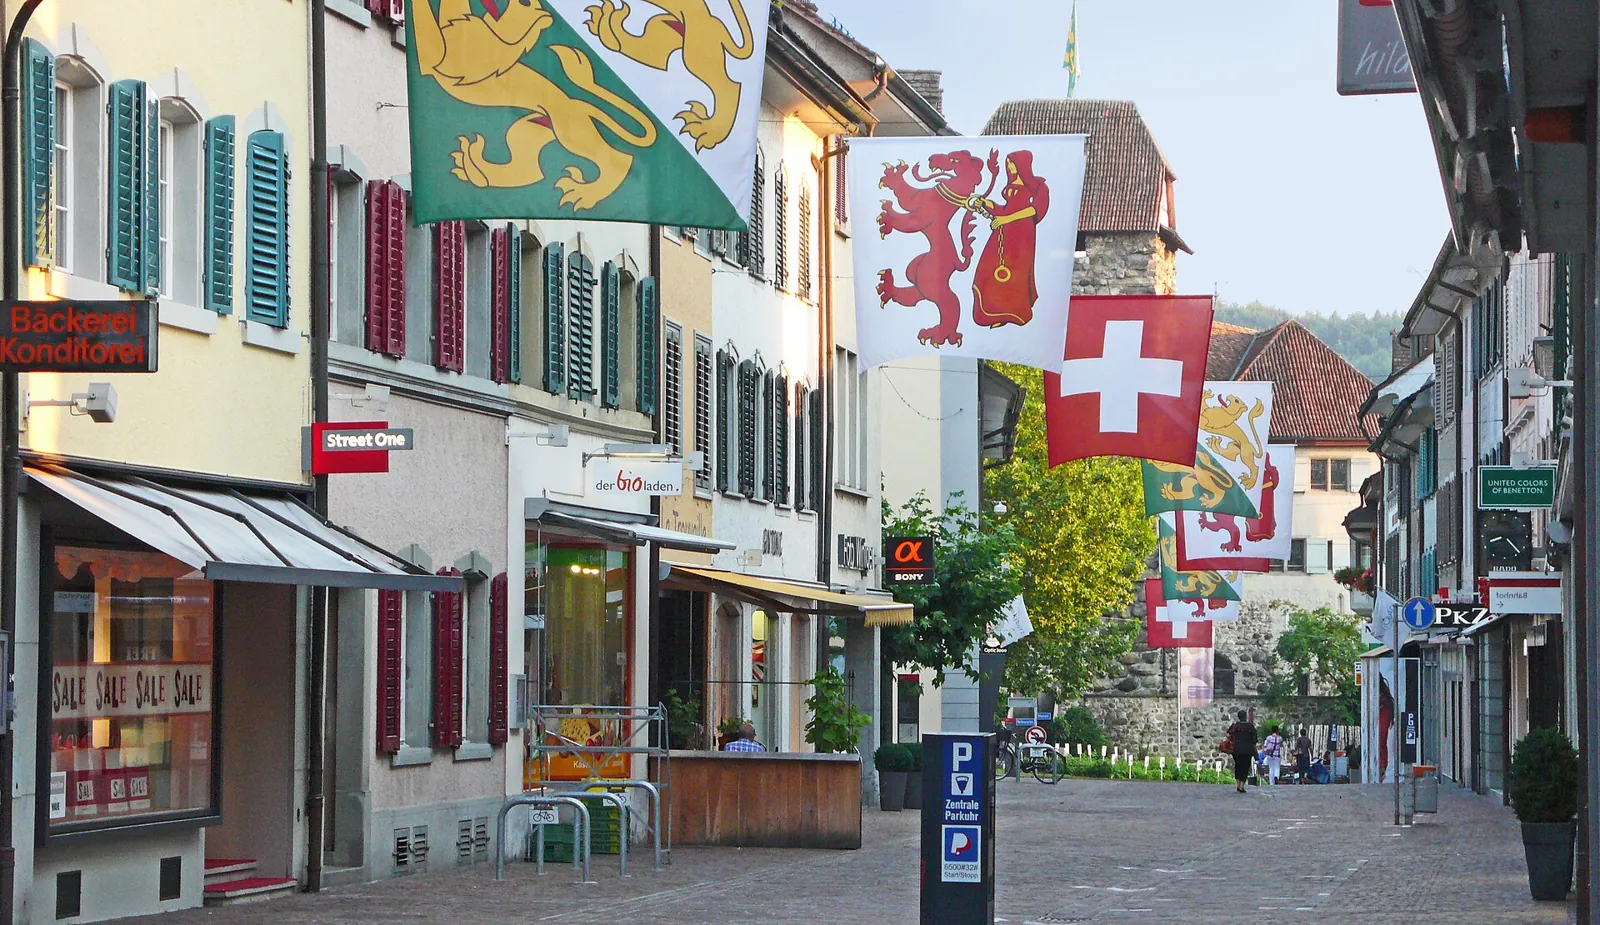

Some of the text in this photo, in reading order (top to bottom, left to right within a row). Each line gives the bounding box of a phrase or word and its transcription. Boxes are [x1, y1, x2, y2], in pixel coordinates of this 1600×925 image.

[11, 305, 137, 333] Bäckerei
[0, 336, 145, 364] Konditorei
[327, 432, 405, 447] Street One
[894, 573, 924, 581] SONY
[53, 669, 203, 713] SALE SALE SALE SALE
[952, 742, 973, 772] P
[945, 800, 980, 810] Zentrale
[945, 811, 979, 821] Parkuhr
[951, 832, 972, 854] P
